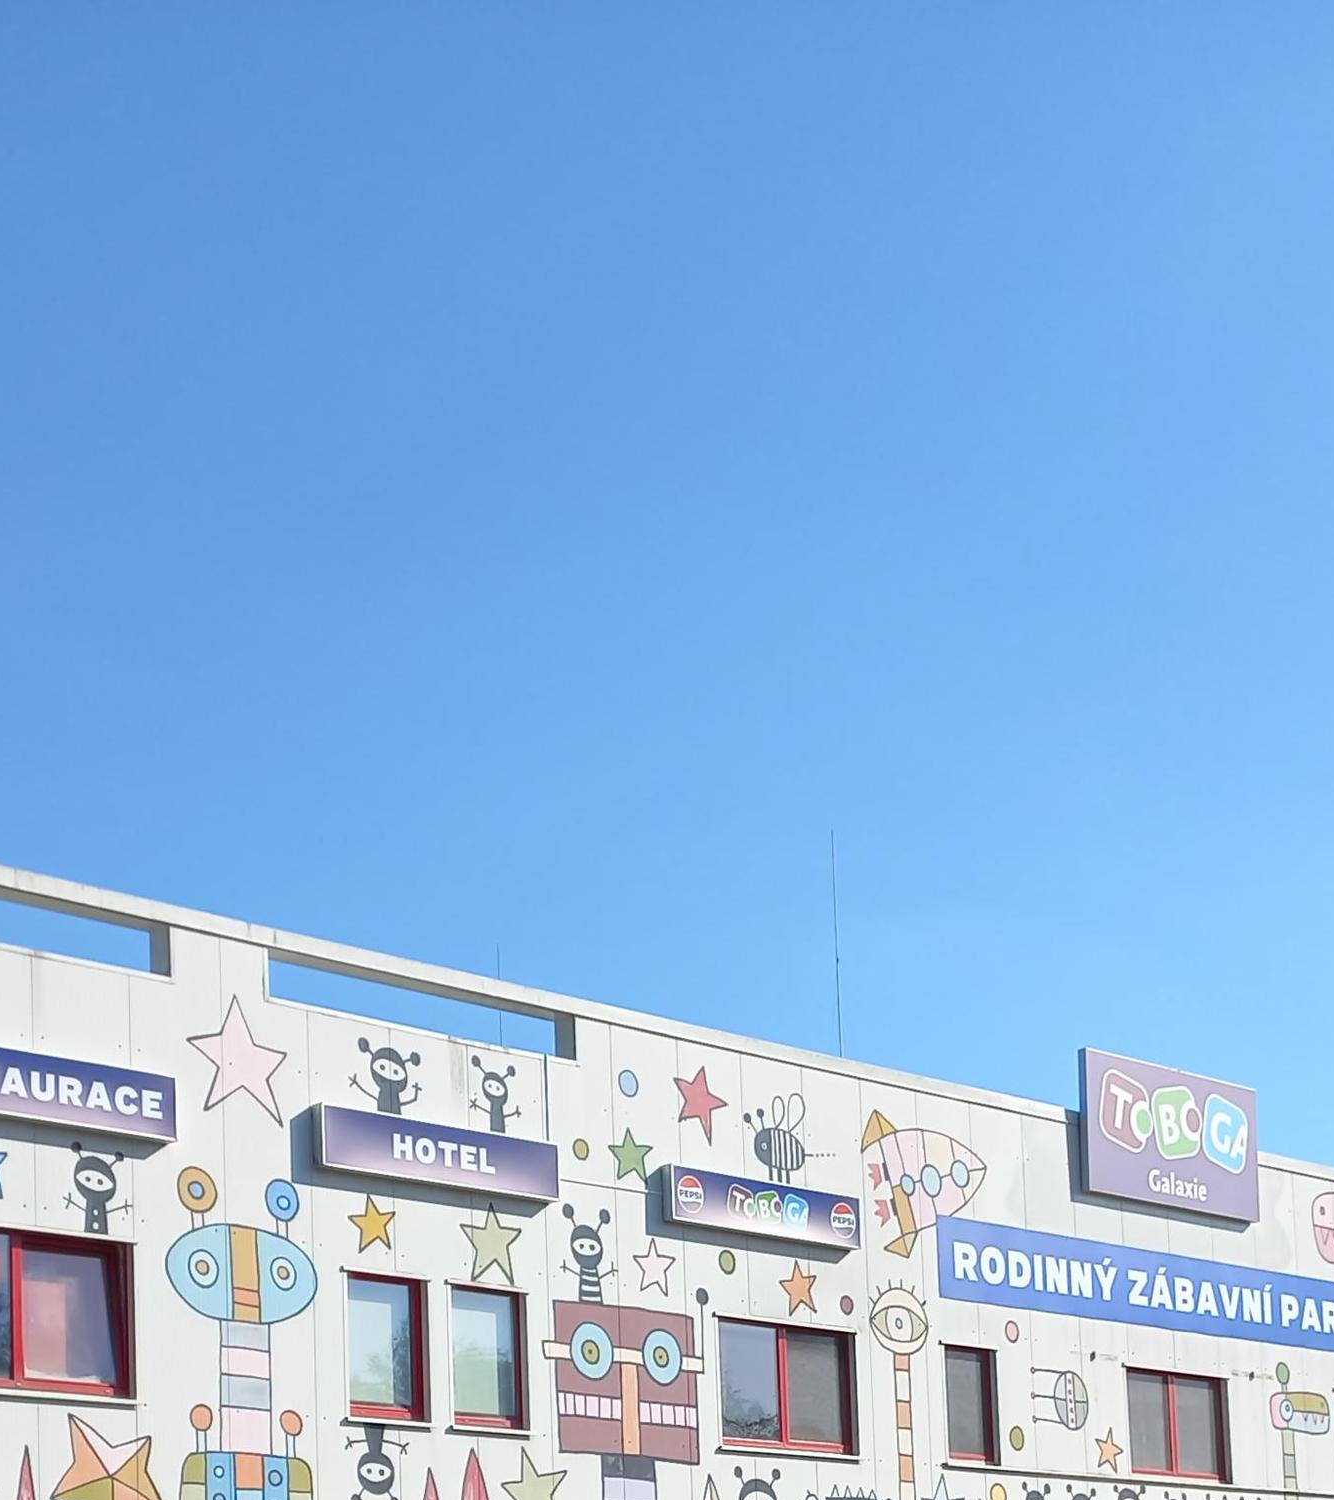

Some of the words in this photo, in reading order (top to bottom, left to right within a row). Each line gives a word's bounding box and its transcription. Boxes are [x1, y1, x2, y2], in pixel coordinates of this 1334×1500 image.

[393, 1132, 496, 1175] HOTEL
[679, 1188, 702, 1199] PEPSI
[1148, 1168, 1208, 1201] Galaxie
[832, 1215, 854, 1227] PEPSI
[952, 1240, 1117, 1301] RODINNÝ
[1127, 1263, 1273, 1325] ZÁBAVNÍ
